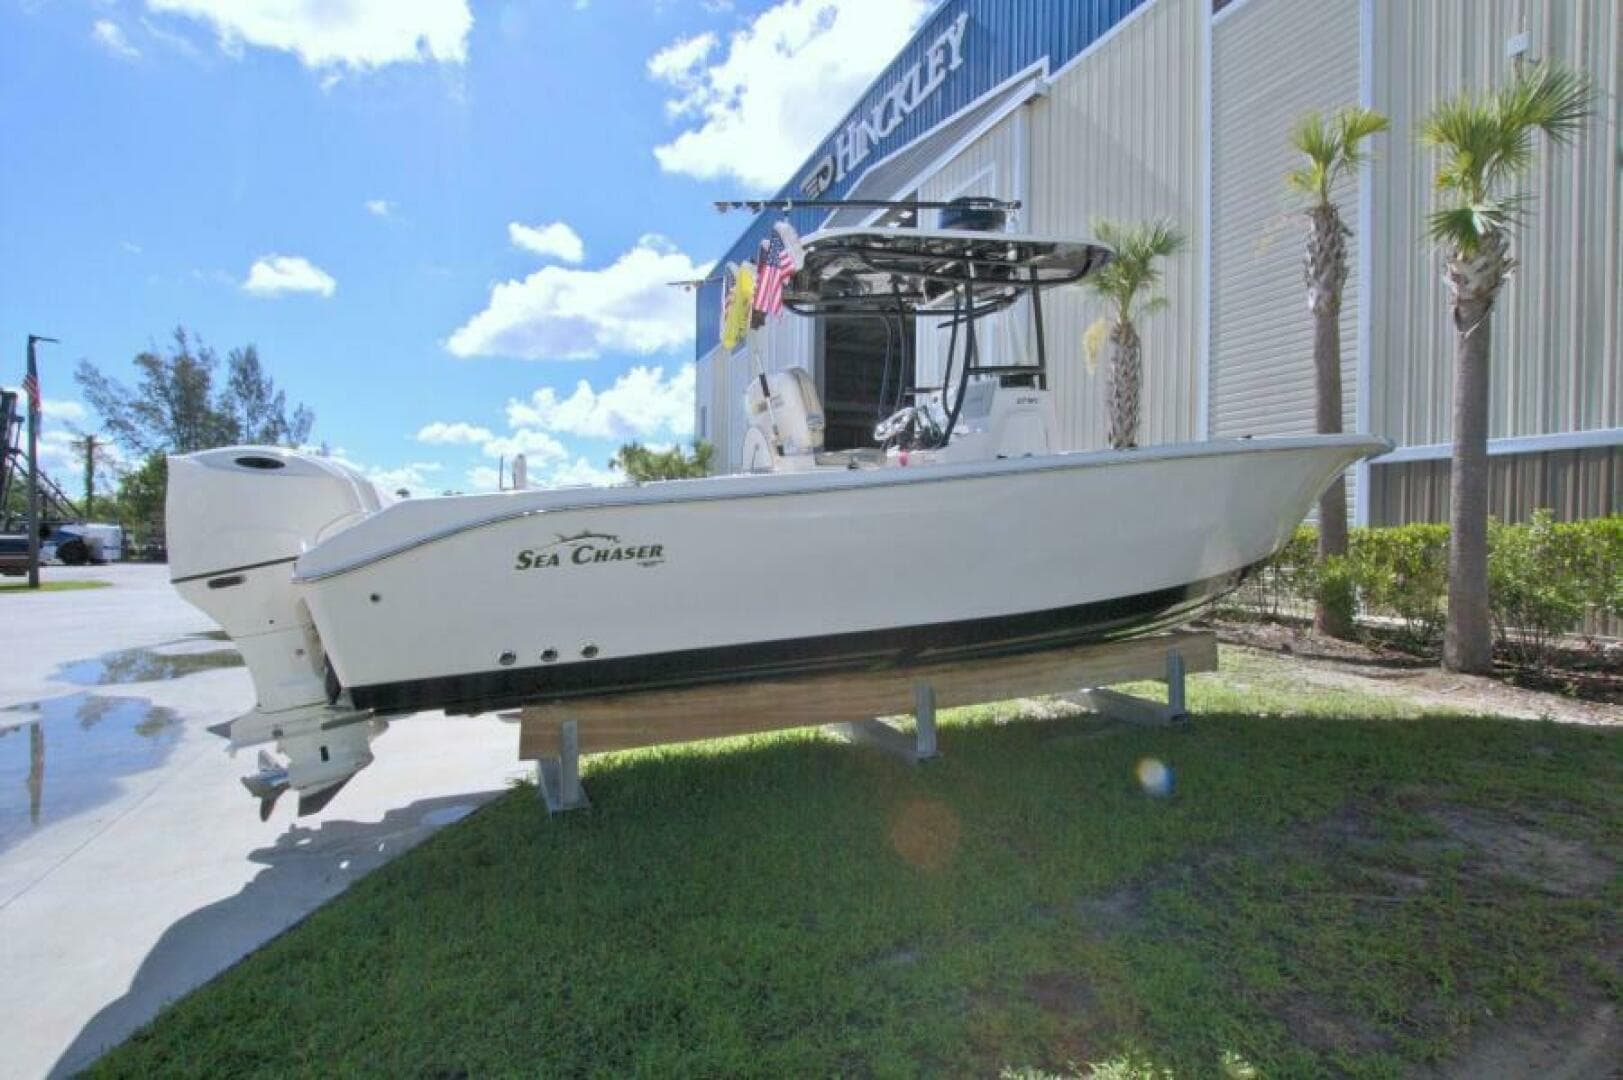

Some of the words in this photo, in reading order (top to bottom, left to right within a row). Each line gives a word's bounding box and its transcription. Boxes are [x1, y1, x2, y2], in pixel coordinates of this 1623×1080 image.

[834, 11, 969, 183] HINCKLEY
[515, 549, 560, 571] SEA
[571, 544, 664, 565] CHASER
